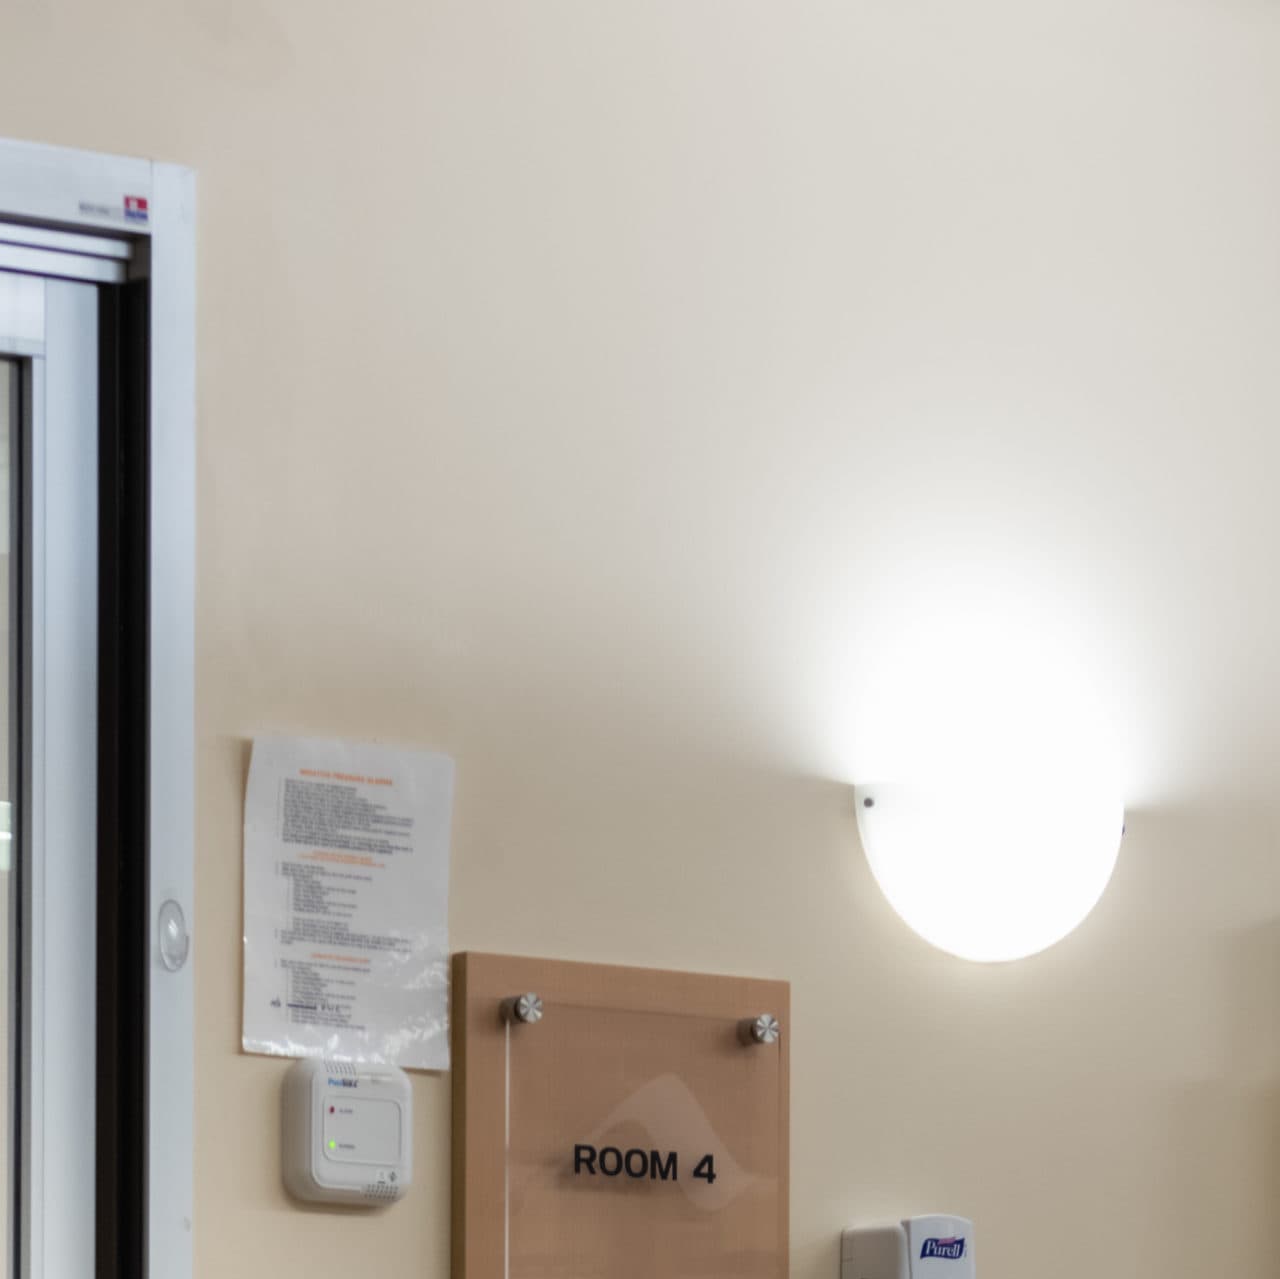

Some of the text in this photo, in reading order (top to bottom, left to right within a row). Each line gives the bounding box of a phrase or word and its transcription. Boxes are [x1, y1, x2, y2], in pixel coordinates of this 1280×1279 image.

[573, 1144, 716, 1184] ROOM 4
[926, 1241, 960, 1258] Purell
